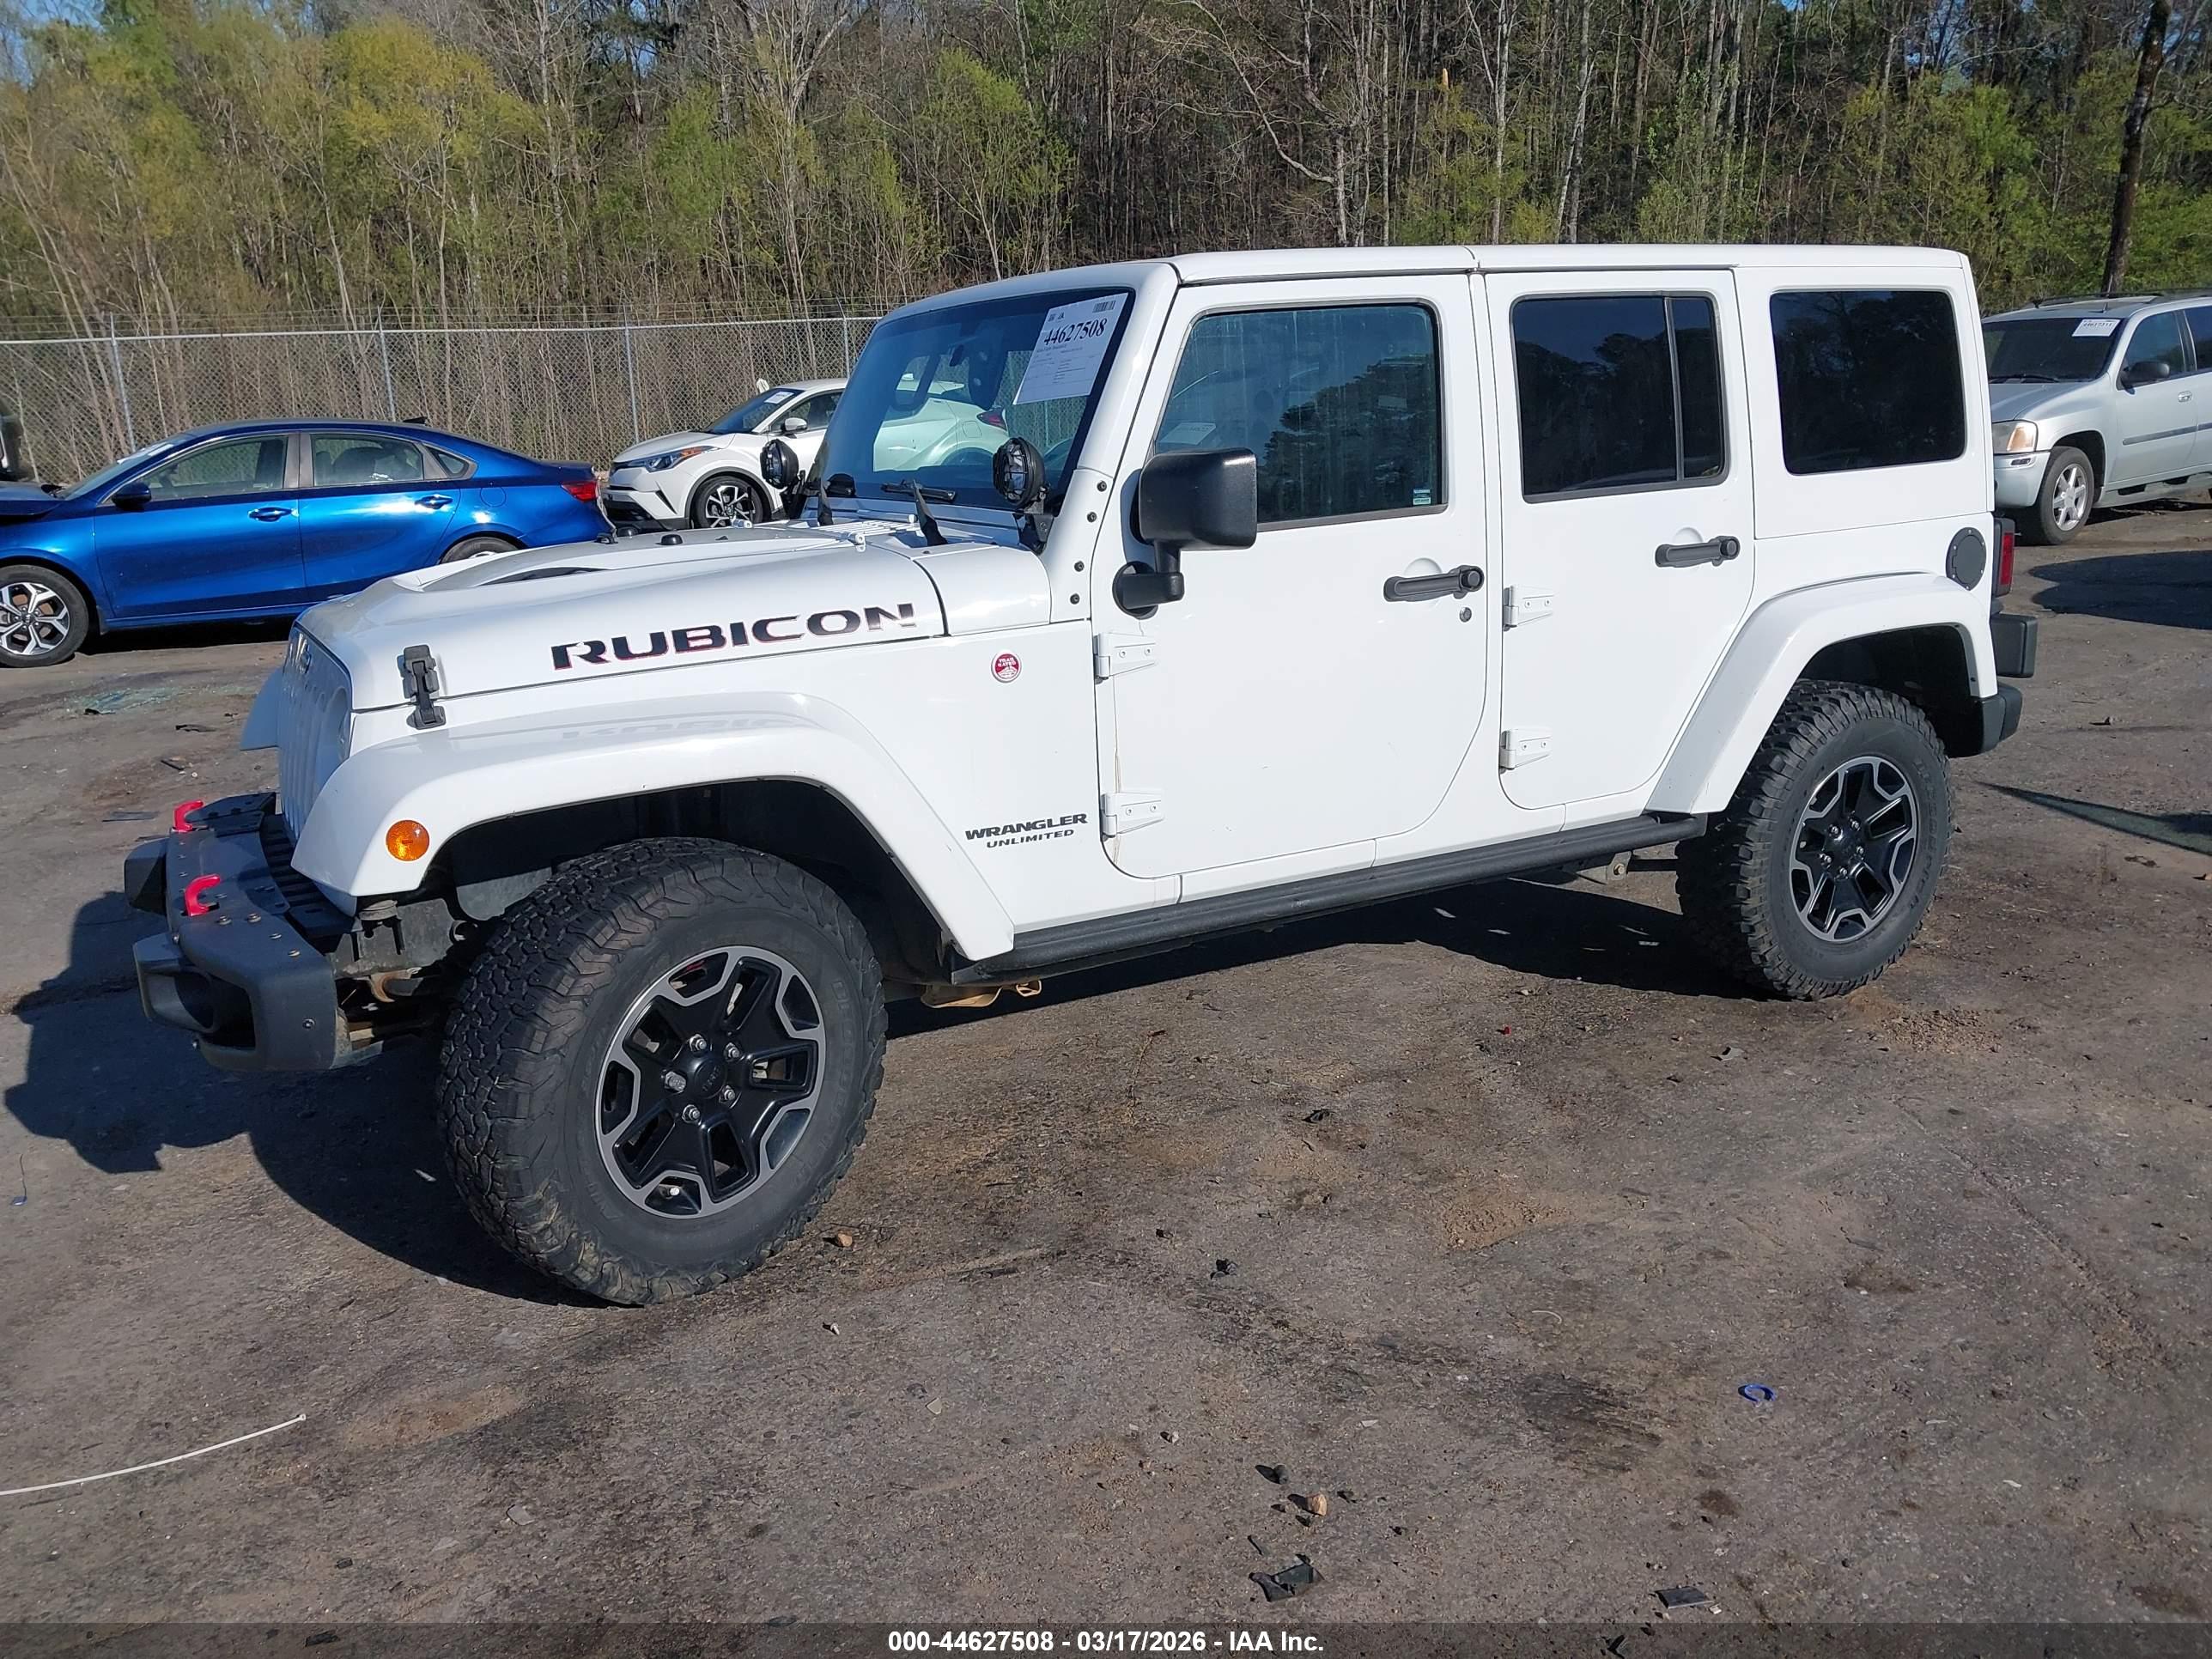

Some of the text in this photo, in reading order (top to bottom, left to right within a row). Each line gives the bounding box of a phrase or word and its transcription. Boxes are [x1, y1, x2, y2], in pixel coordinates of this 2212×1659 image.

[1043, 318, 1108, 345] 44627508
[550, 603, 917, 670] RUBICON
[964, 813, 1088, 841] WRANGLER
[987, 829, 1075, 848] UNLIMITED
